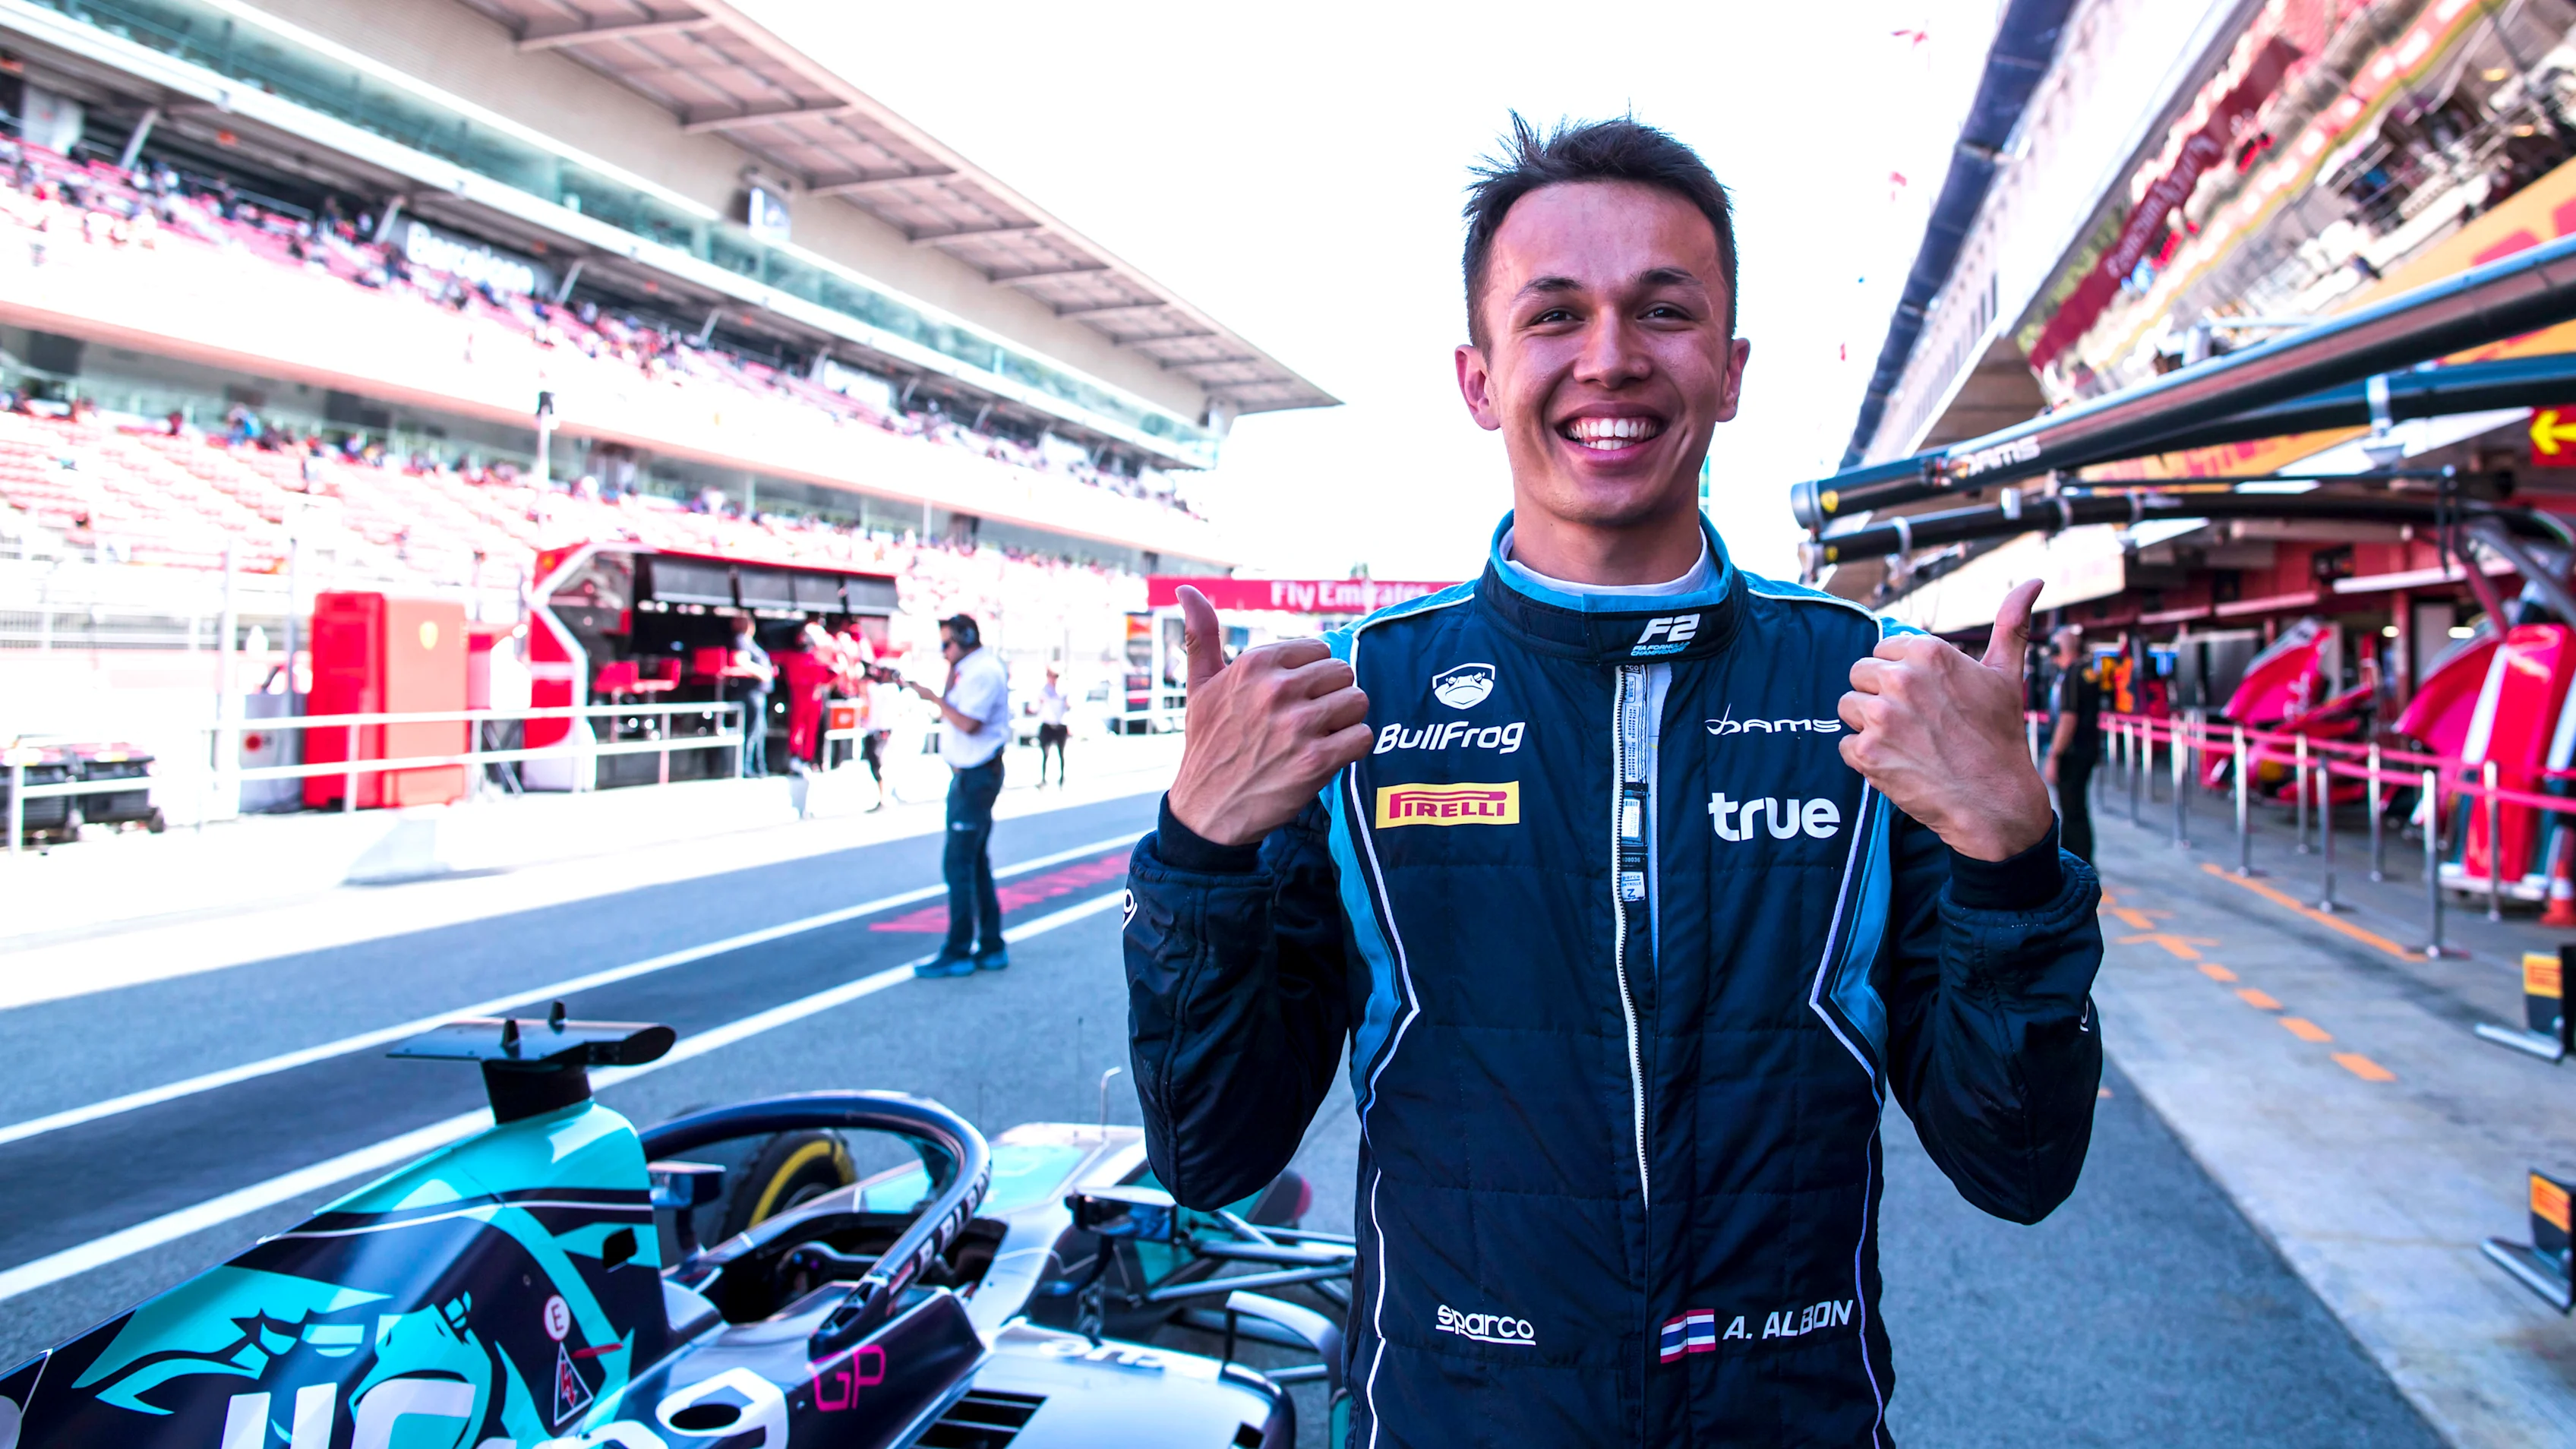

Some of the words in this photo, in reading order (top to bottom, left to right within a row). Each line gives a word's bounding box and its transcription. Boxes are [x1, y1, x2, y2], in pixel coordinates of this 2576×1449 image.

[1271, 582, 1316, 611] Fly
[1637, 614, 1700, 644] F2
[1373, 721, 1526, 754] BullFrog
[1389, 791, 1507, 819] PIRELLI
[1708, 793, 1841, 841] true
[550, 1303, 564, 1332] E
[1436, 1305, 1536, 1341] sparco
[1722, 1316, 1753, 1340] A.
[1762, 1300, 1854, 1340] ALBON
[807, 1344, 886, 1412] GP
